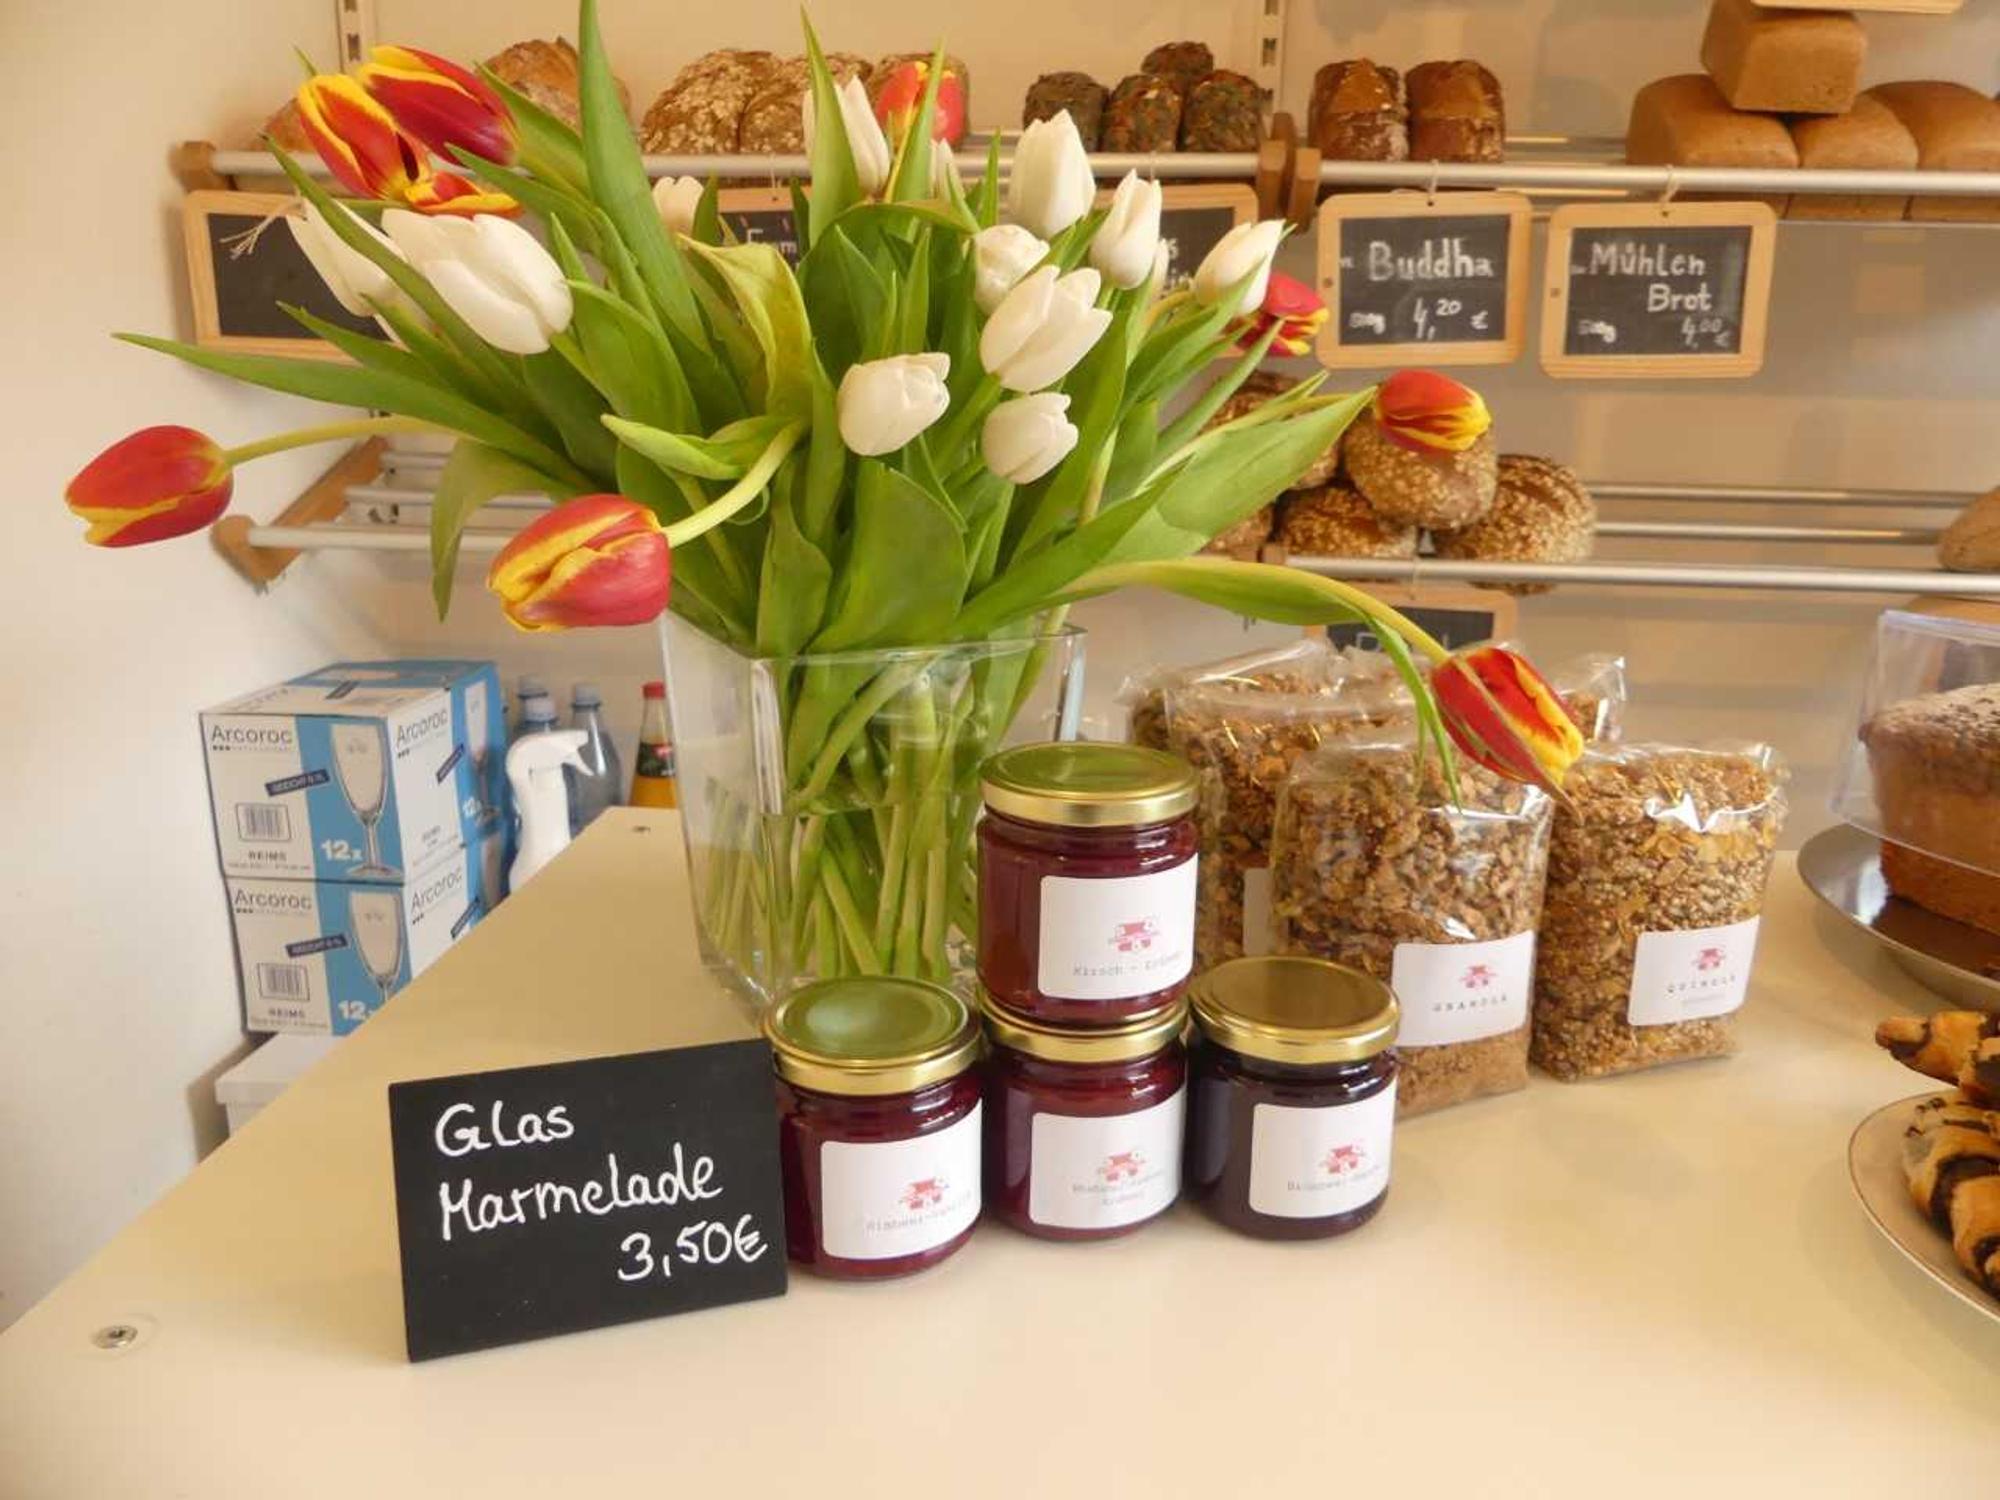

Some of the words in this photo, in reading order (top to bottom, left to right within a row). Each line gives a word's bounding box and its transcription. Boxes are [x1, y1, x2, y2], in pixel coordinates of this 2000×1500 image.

[1368, 237, 1493, 281] Buddha
[1589, 241, 1707, 276] Mühlen
[1647, 282, 1712, 312] Brot
[211, 725, 293, 745] Arcoroc
[396, 708, 448, 746] Arcoroc
[234, 889, 313, 910] Arcoroc
[410, 867, 463, 910] Arcoroc
[434, 1100, 576, 1157] Glas
[439, 1141, 723, 1241] Marmelade
[616, 1213, 769, 1281] 3,50€
